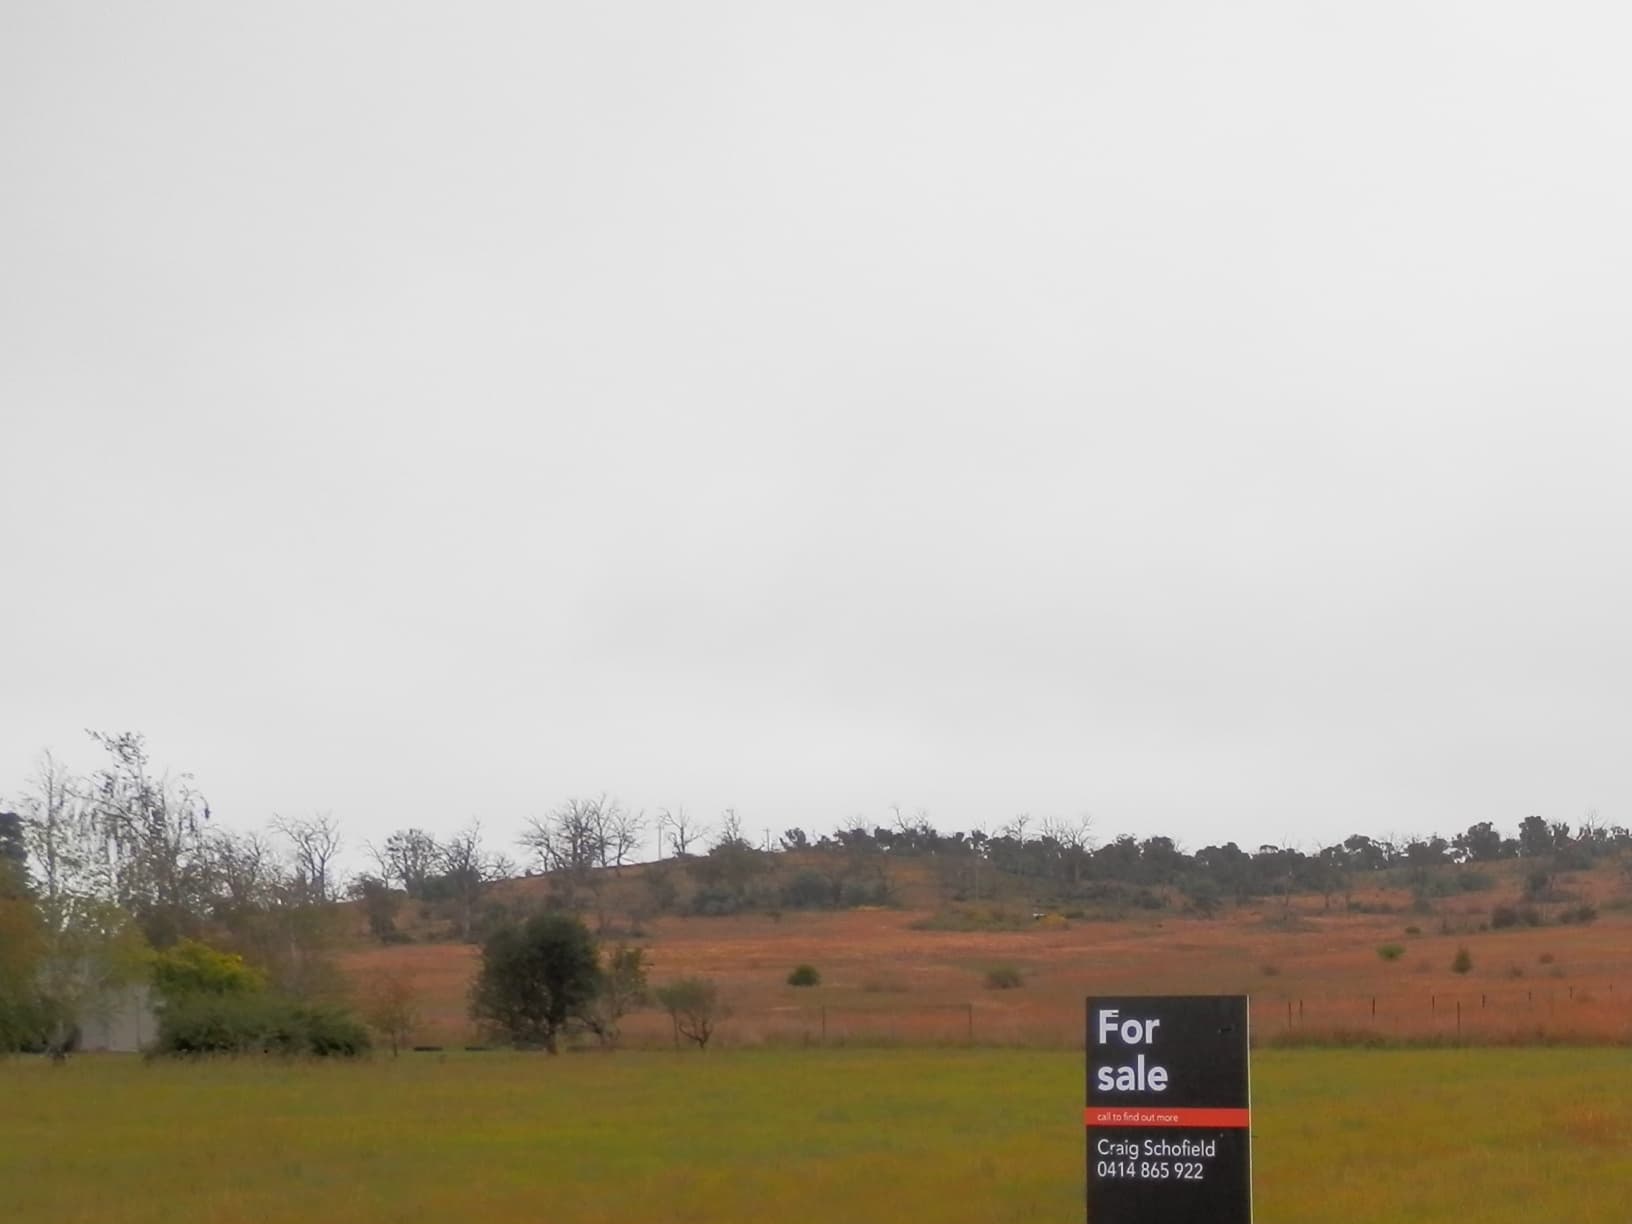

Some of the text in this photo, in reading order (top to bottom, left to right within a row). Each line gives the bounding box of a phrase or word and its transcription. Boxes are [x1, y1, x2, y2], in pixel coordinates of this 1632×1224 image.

[1099, 1009, 1160, 1044] For
[1098, 1054, 1168, 1091] sale
[1097, 1112, 1179, 1122] call to find out more
[1097, 1138, 1216, 1160] Craig Schofield
[1097, 1161, 1204, 1179] 0414 865 922
